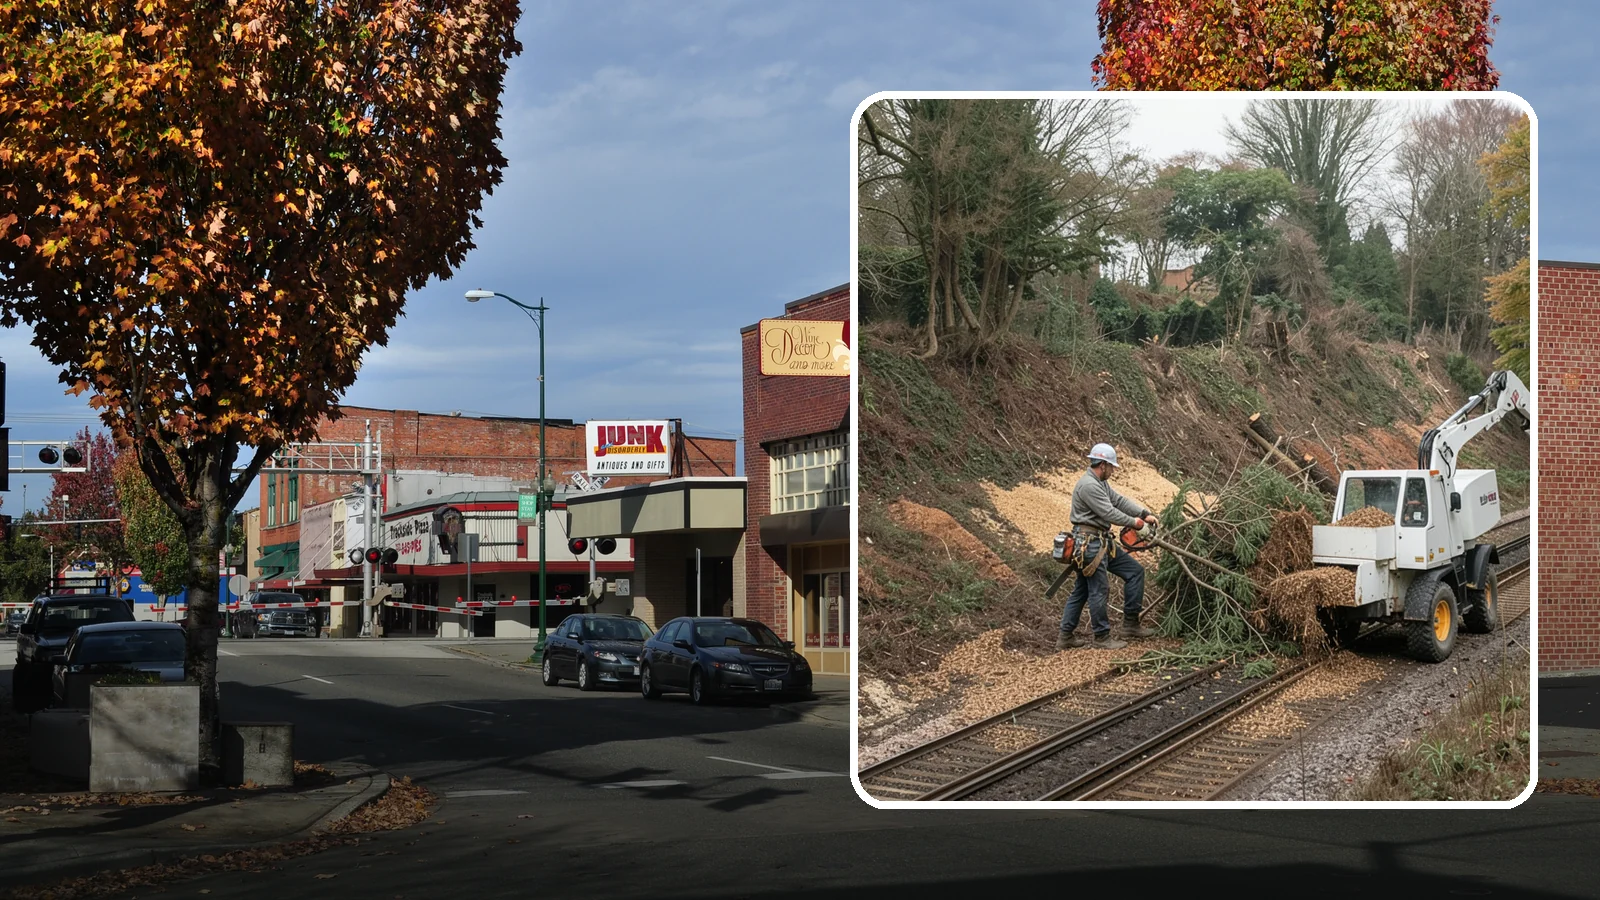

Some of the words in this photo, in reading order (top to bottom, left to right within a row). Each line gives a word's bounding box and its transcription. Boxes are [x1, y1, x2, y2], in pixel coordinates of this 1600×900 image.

[595, 425, 665, 457] JUNK
[607, 446, 646, 454] DISORDERLY
[597, 461, 628, 470] ANTIQUES
[631, 461, 644, 470] AND
[647, 460, 666, 469] GIFTS
[414, 519, 429, 534] Pizza
